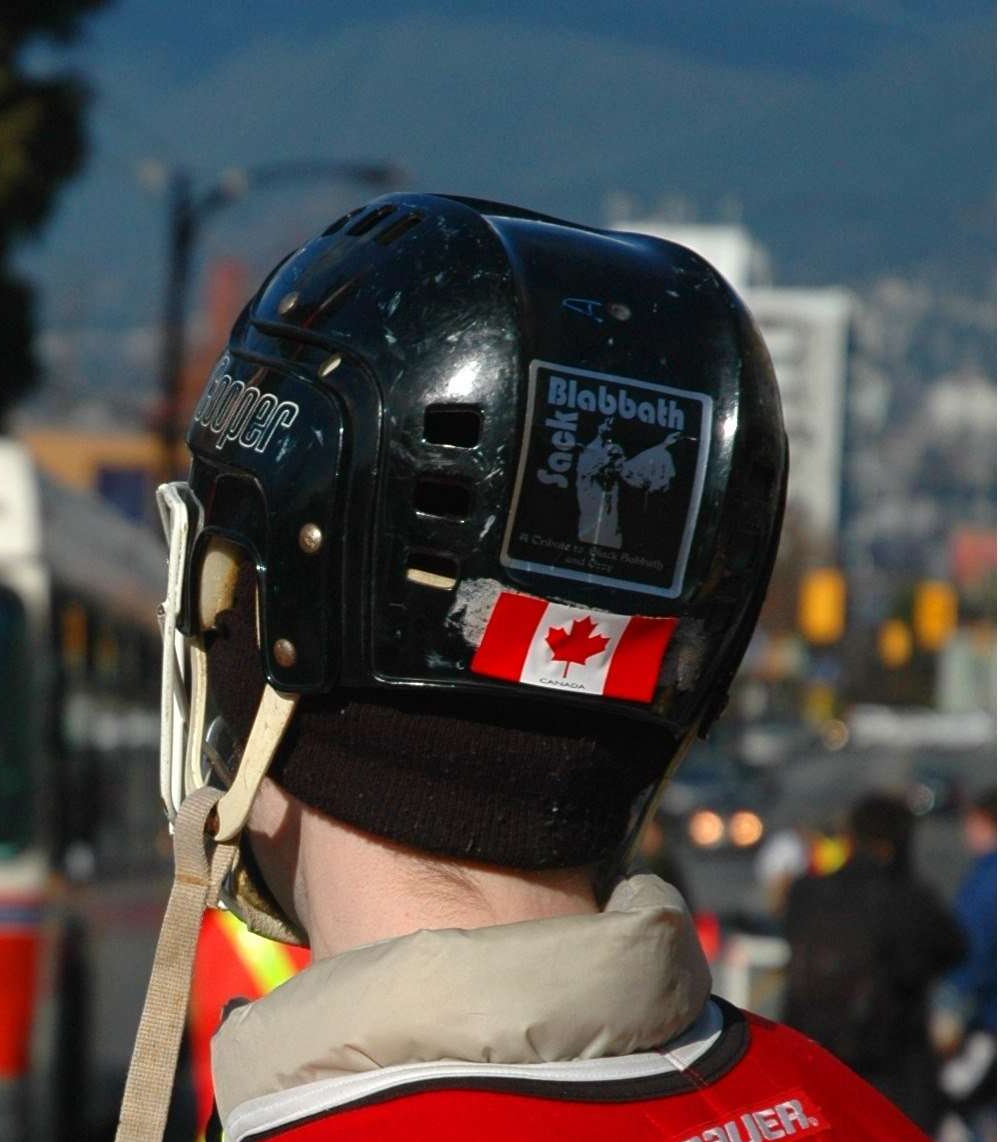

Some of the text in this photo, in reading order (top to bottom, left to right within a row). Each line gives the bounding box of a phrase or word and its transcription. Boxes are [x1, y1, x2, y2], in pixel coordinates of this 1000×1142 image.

[537, 376, 686, 489] Sack Blabbath
[538, 677, 586, 690] CANADA
